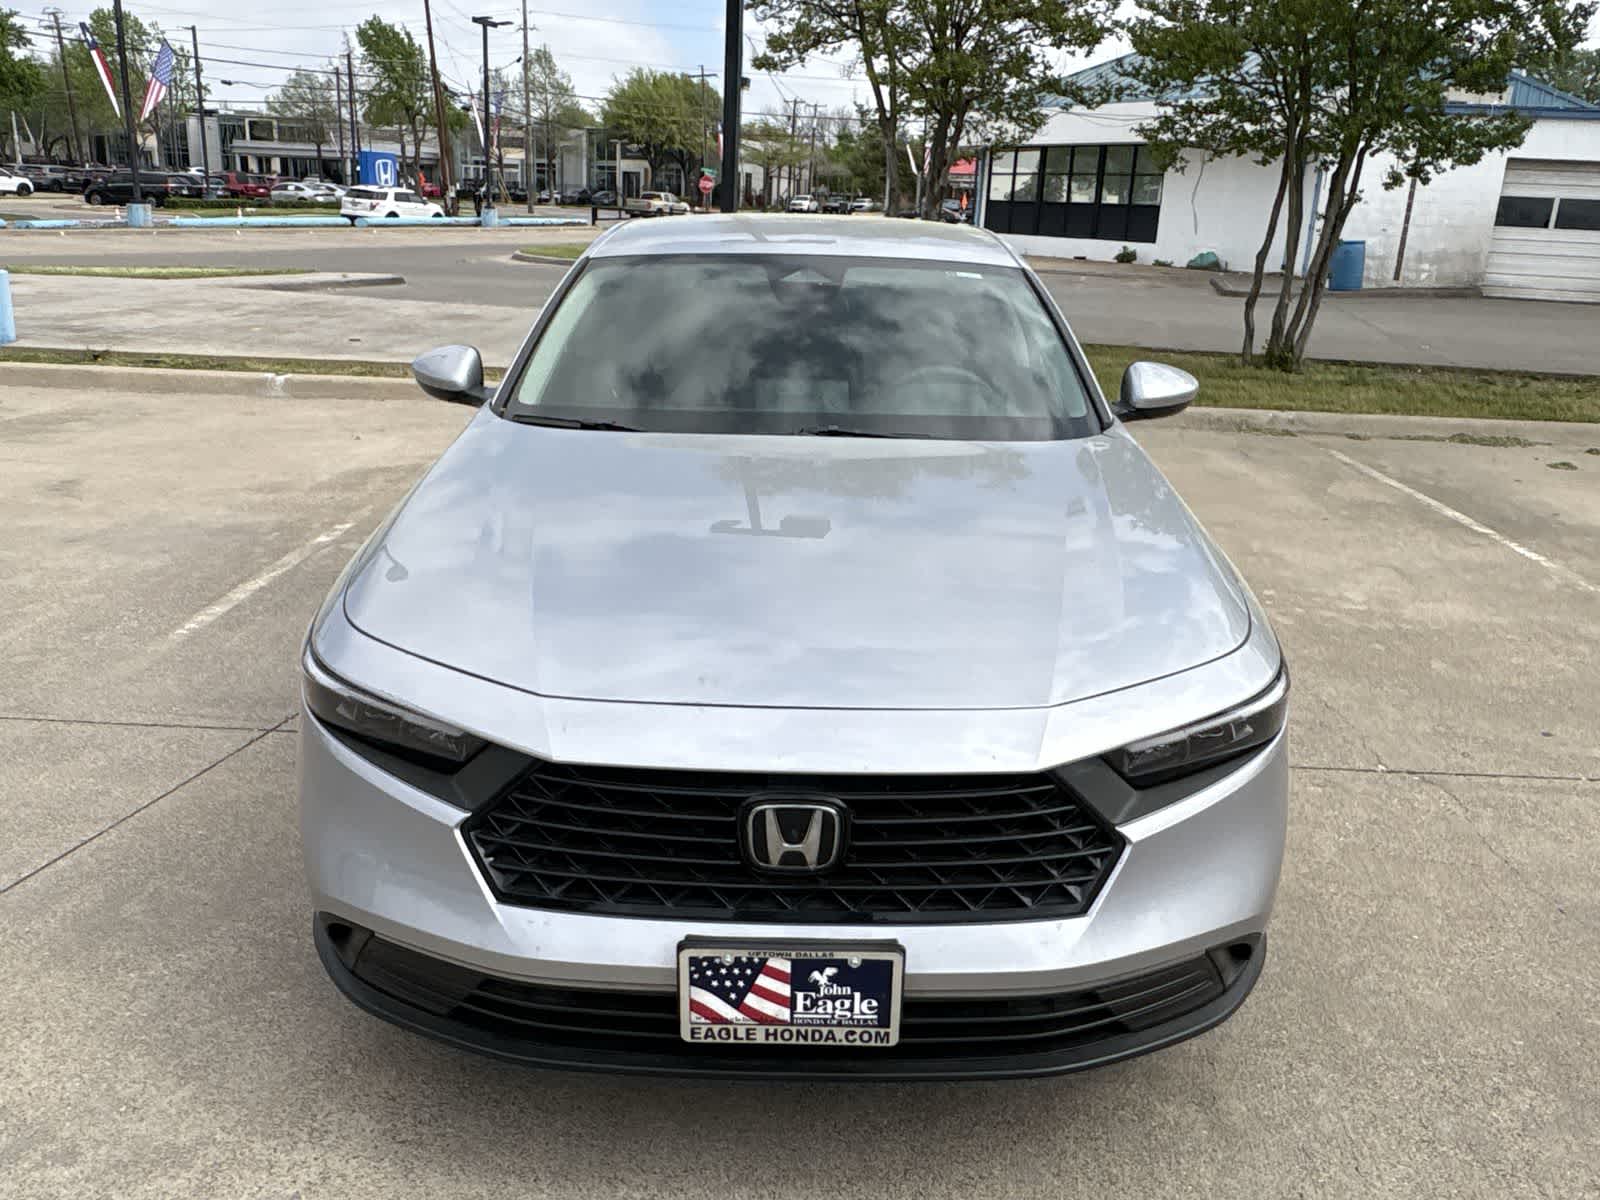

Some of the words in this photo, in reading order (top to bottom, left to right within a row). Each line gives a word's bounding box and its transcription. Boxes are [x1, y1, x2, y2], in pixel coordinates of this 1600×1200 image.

[816, 983, 851, 998] John
[794, 991, 879, 1019] Eagle
[690, 1027, 757, 1041] EAGLE
[764, 1028, 890, 1044] HONDA.COM
